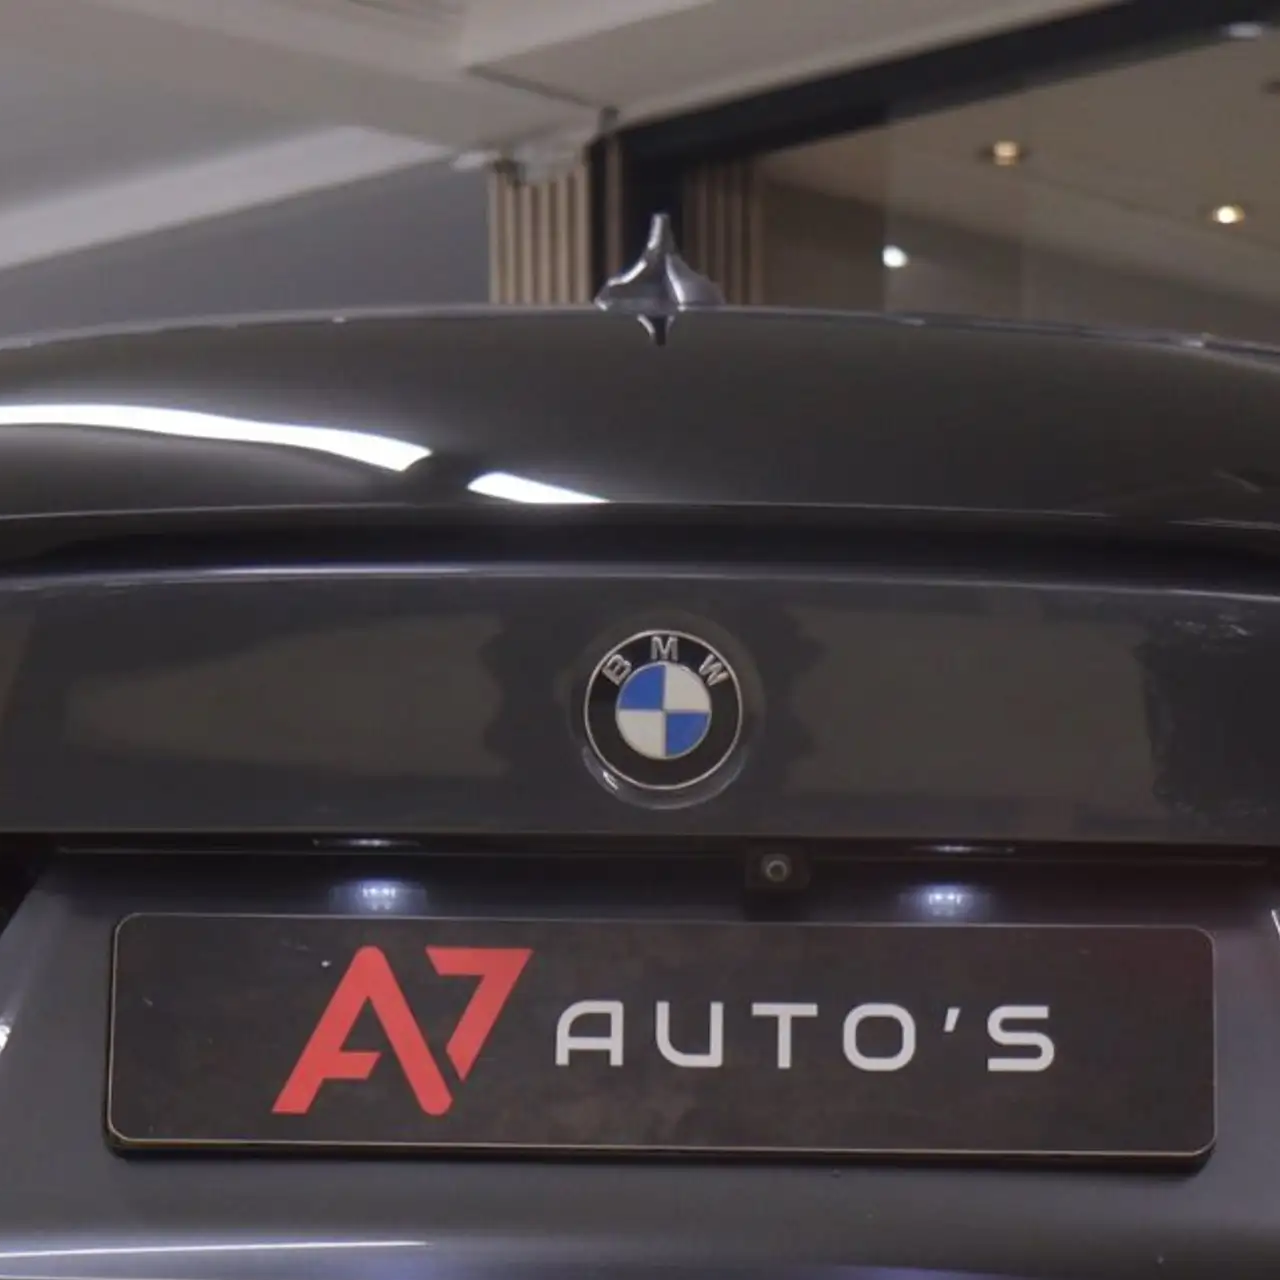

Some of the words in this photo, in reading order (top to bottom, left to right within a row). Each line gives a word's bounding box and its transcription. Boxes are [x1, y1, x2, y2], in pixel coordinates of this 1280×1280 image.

[601, 635, 730, 687] BMW
[272, 945, 533, 1116] A7
[554, 999, 1056, 1073] AUTO'S
